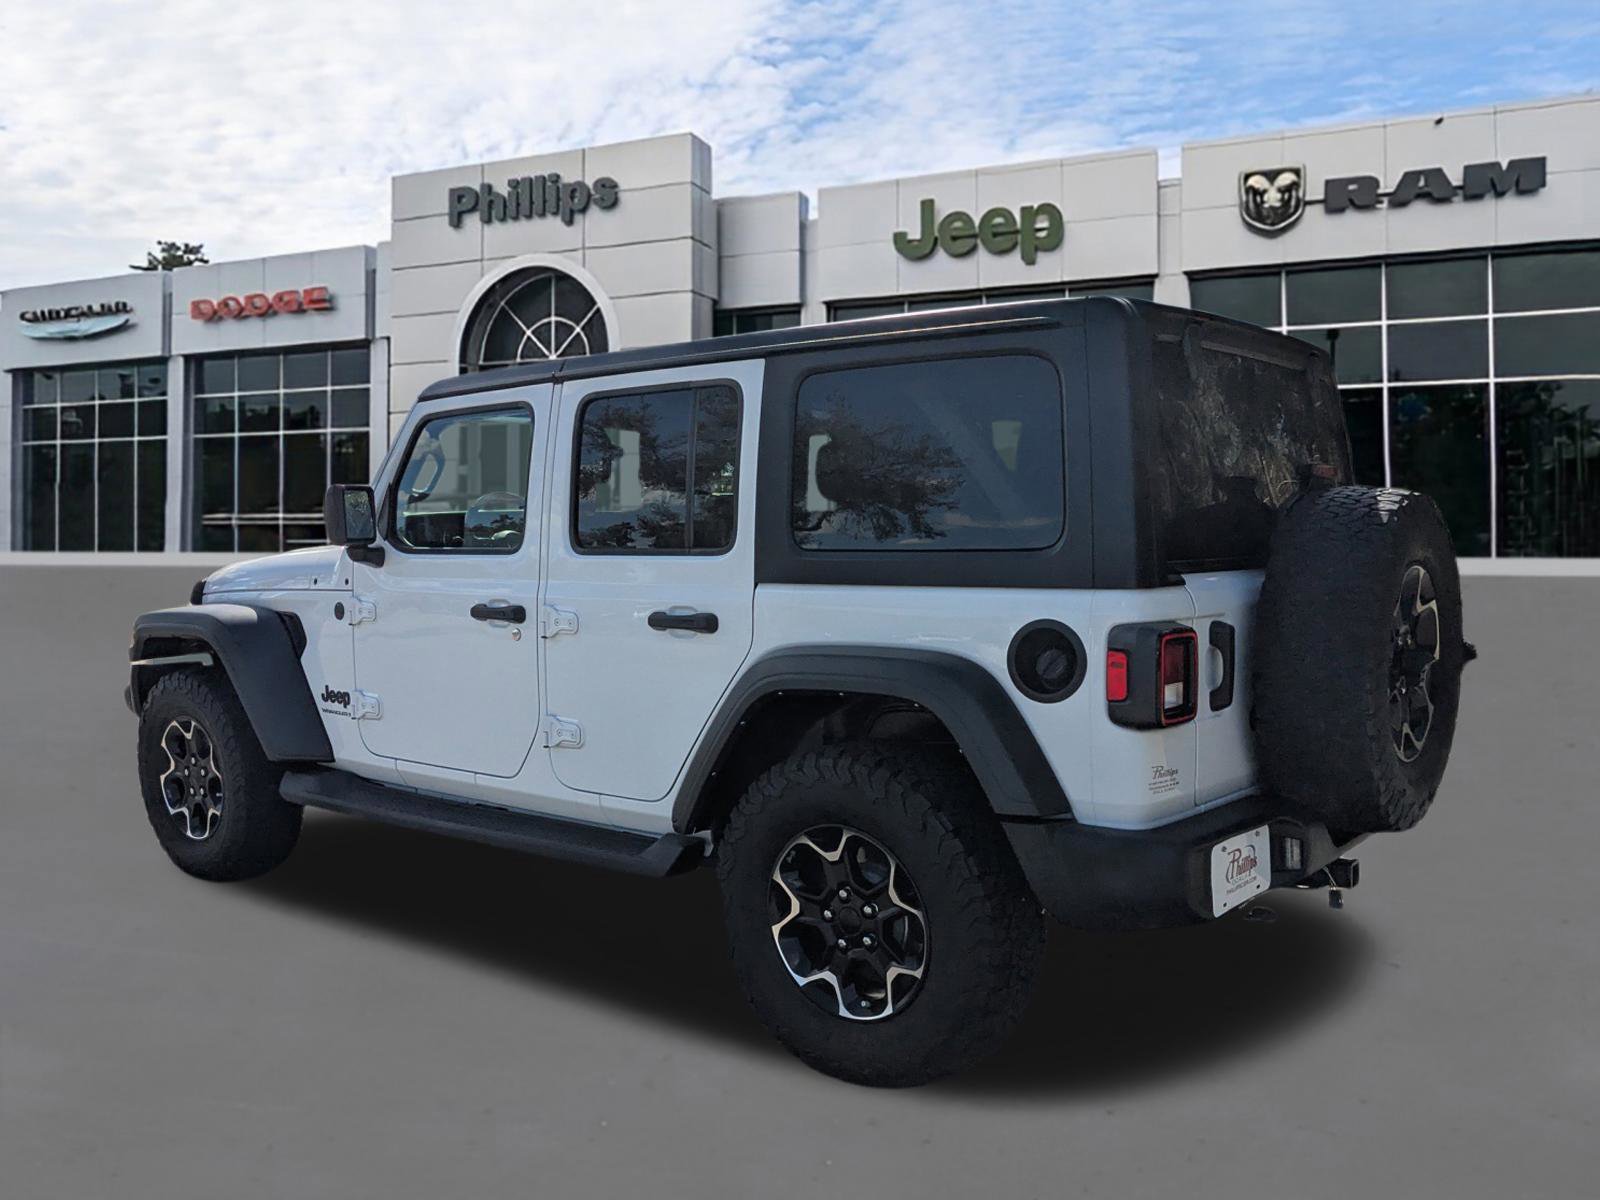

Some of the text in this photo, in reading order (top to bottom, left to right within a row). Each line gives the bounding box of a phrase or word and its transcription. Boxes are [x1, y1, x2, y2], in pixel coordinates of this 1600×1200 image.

[448, 173, 619, 228] Phillips
[1325, 156, 1546, 214] RAM
[893, 199, 1064, 265] Jeep
[191, 286, 331, 321] DODGE
[321, 684, 351, 708] Jeep
